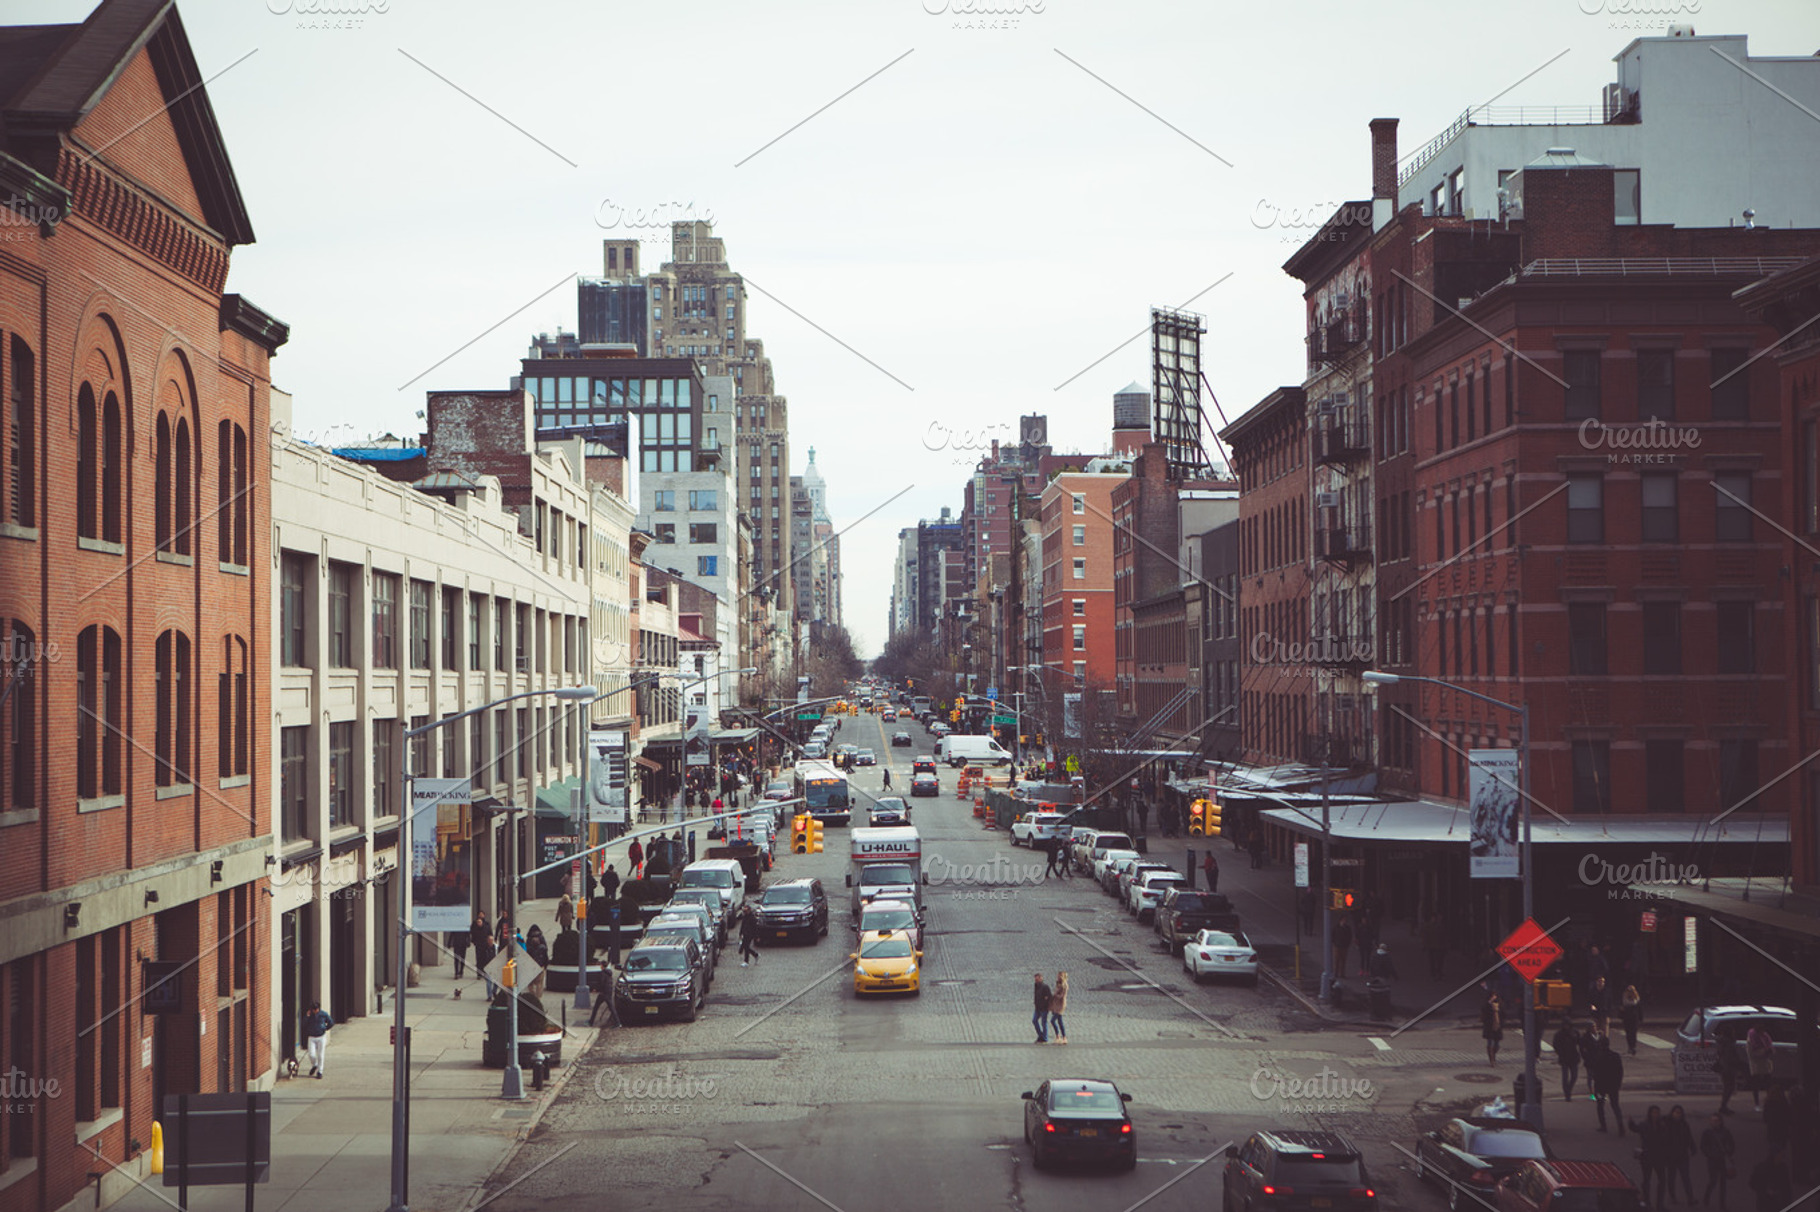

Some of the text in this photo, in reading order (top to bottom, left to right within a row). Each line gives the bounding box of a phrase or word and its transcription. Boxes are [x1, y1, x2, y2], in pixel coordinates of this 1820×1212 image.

[861, 844, 911, 853] U-HAUL
[1517, 958, 1542, 966] AHEAD
[1678, 1052, 1720, 1062] SIDEWA
[1683, 1063, 1714, 1072] CLOS
